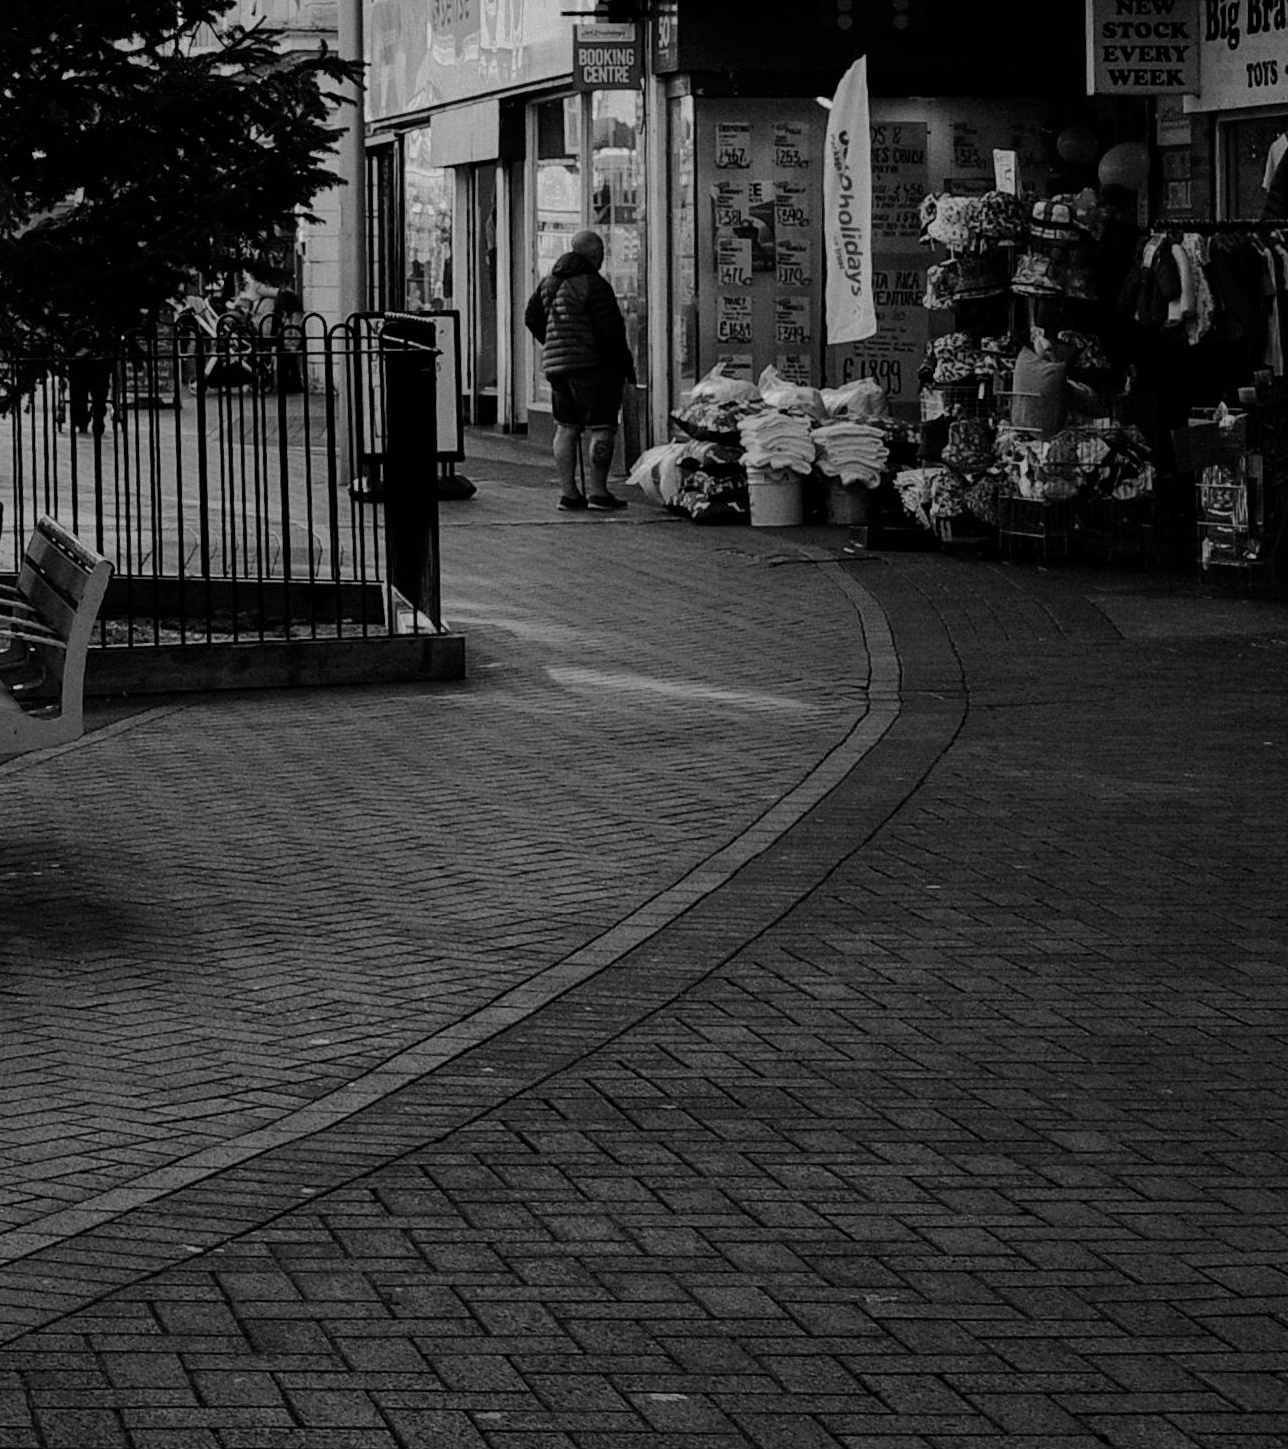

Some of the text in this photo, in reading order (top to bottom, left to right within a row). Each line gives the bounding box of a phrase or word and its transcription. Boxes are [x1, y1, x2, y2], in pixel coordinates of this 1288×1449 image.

[1102, 22, 1189, 39] STOCK
[578, 48, 635, 66] BOOKING
[1103, 45, 1190, 62] EVERY
[583, 66, 630, 84] CENTRE
[1108, 69, 1185, 86] WEEK
[1247, 60, 1278, 88] TOYS
